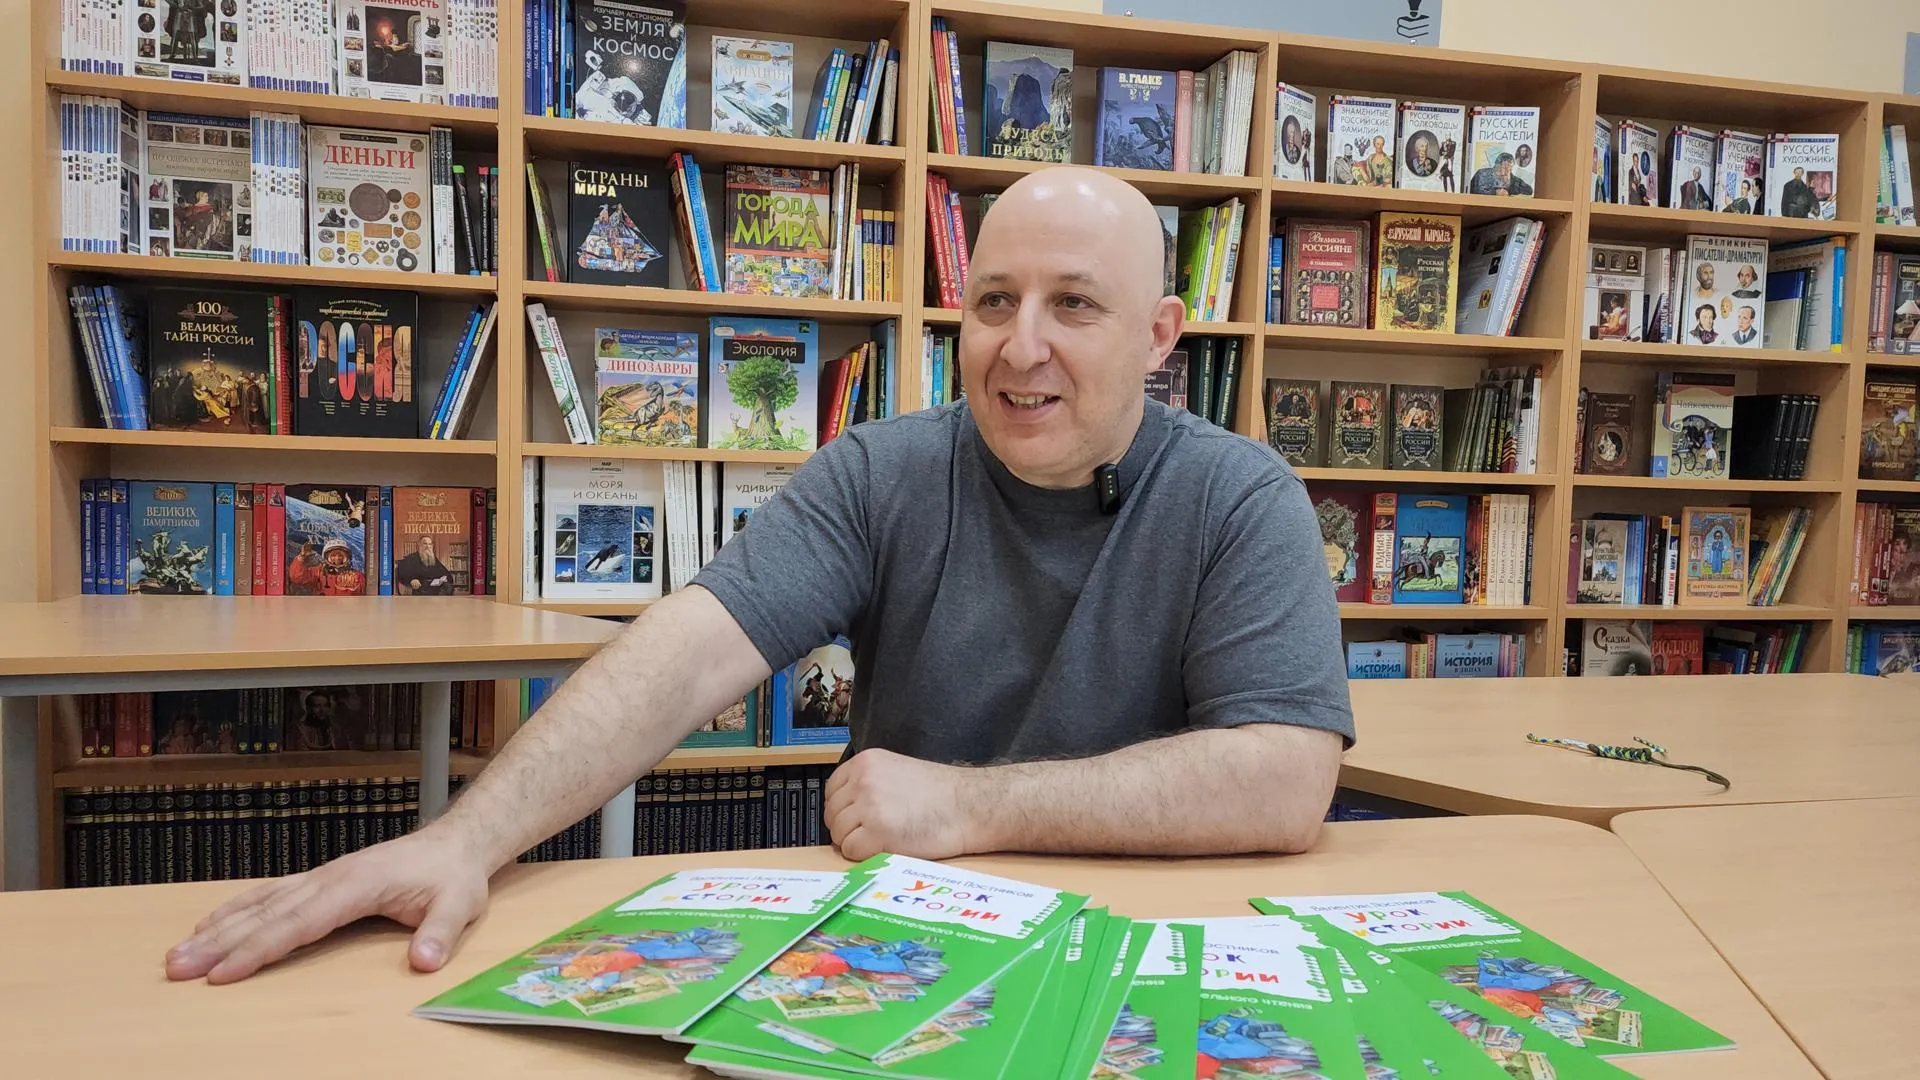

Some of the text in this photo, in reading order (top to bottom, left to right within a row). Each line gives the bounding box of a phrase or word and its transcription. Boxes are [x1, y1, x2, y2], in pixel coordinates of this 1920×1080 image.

[593, 6, 625, 18] ИЗУЧАЕМ
[626, 10, 674, 24] АСТРОНОМИЮ
[601, 15, 665, 38] ЗЕМЛЯ
[630, 34, 637, 42] И
[593, 36, 675, 62] КОСМОС
[1341, 106, 1389, 117] ЗНАМЕНИТЫЕ
[1409, 112, 1440, 121] РУССКИЕ
[1340, 116, 1390, 127] РОССИЙСКИЕ
[1409, 119, 1458, 130] ПОЛКОВОДЦЫ
[1480, 118, 1529, 129] РУССКИЕ
[1001, 126, 1060, 143] ЧУДЕСА
[1340, 126, 1379, 135] ФАМИЛИИ
[1479, 130, 1535, 141] ПИСАТЕЛИ
[992, 143, 1072, 161] ПРИРОДЫ
[1728, 141, 1760, 155] РУССКИЕ
[1783, 145, 1832, 155] РУССКИЕ
[323, 144, 416, 170] ДЕНЬГИ
[1782, 156, 1835, 165] ХУДОЖНИКИ
[574, 169, 649, 188] СТРАНЫ
[574, 183, 617, 198] МИРА
[737, 193, 820, 218] ГОРОДА
[733, 215, 823, 249] МИРА
[1302, 243, 1353, 254] РОССИЯНЕ
[1708, 238, 1752, 248] ВЕЛИКИЕ
[958, 239, 967, 264] КНИГА
[1694, 247, 1764, 265] ПИСАТЕЛИ-ДРАМАТУРГИ
[1496, 247, 1521, 312] ИСТОРИЯ РОССИИ
[196, 301, 222, 316] 100
[180, 322, 238, 334] ВЕЛИКИХ
[163, 331, 255, 346] ТАЙН РОССИИ
[1232, 340, 1238, 348] 2
[732, 341, 798, 357] Экология
[298, 320, 412, 403] РОССИЯ
[606, 359, 693, 376] ДИНОЗАВРЫ
[588, 480, 623, 489] МОРЯ
[573, 491, 638, 500] И ОКЕАНЫ
[146, 506, 198, 518] ВЕЛИКИХ
[408, 511, 456, 523] ВЕЛИКИХ
[143, 518, 200, 528] ПАМЯТНИКОВ
[404, 523, 460, 534] ПИСАТЕЛЕЙ
[1375, 534, 1385, 568] РОДНАЯ
[1652, 639, 1699, 655] РЮЛЛОВ
[1355, 663, 1401, 674] ИСТОРИЯ
[1444, 656, 1493, 667] ИСТОРИЯ
[691, 881, 783, 893] УРОК
[902, 868, 1035, 899] Валентин Постников
[660, 893, 791, 904] ИСТОРИИ
[903, 879, 993, 904] УРОК
[872, 890, 1001, 922] ИСТОРИИ
[1344, 908, 1428, 924] УРОК
[1353, 919, 1473, 938] ИСТОРИИ
[1204, 942, 1280, 955] остников
[1203, 952, 1246, 964] ОК
[1201, 967, 1280, 984] ОРИИ
